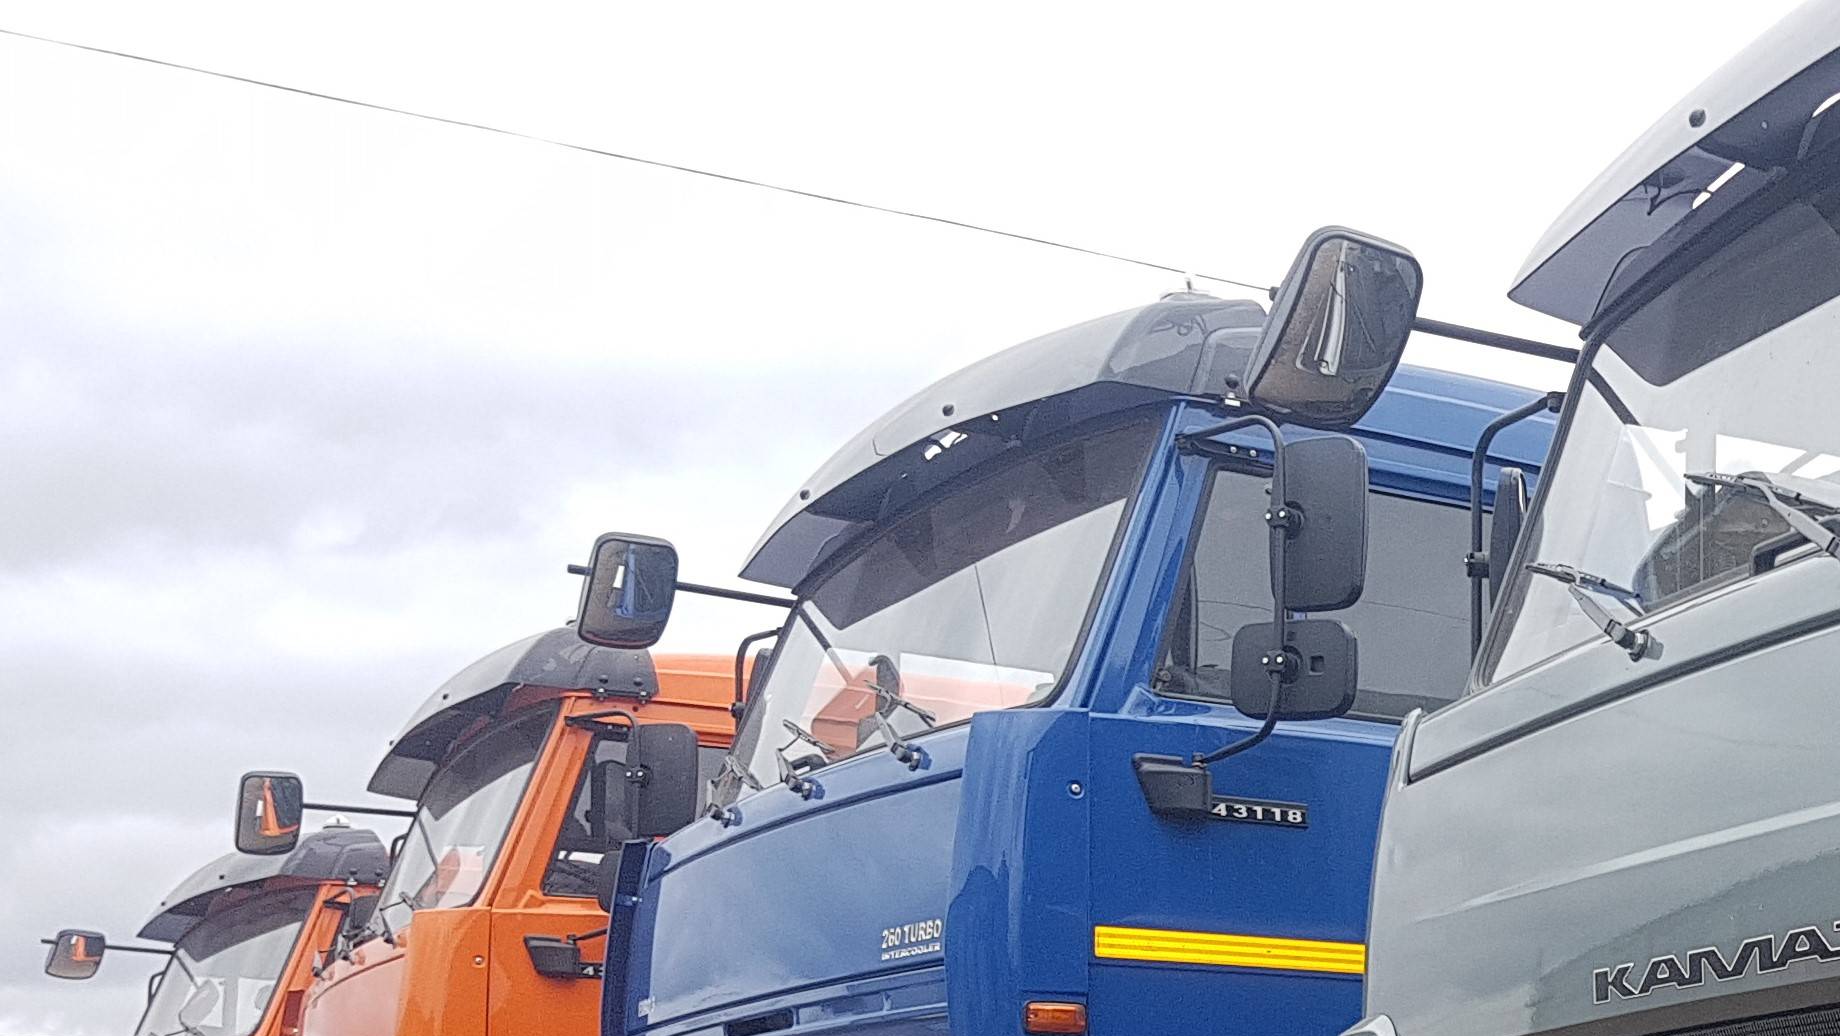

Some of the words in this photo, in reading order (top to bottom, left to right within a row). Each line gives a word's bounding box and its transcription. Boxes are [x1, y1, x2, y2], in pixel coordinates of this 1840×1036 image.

[1211, 803, 1303, 823] 43118
[881, 927, 902, 949] 260
[903, 918, 943, 944] TURBO
